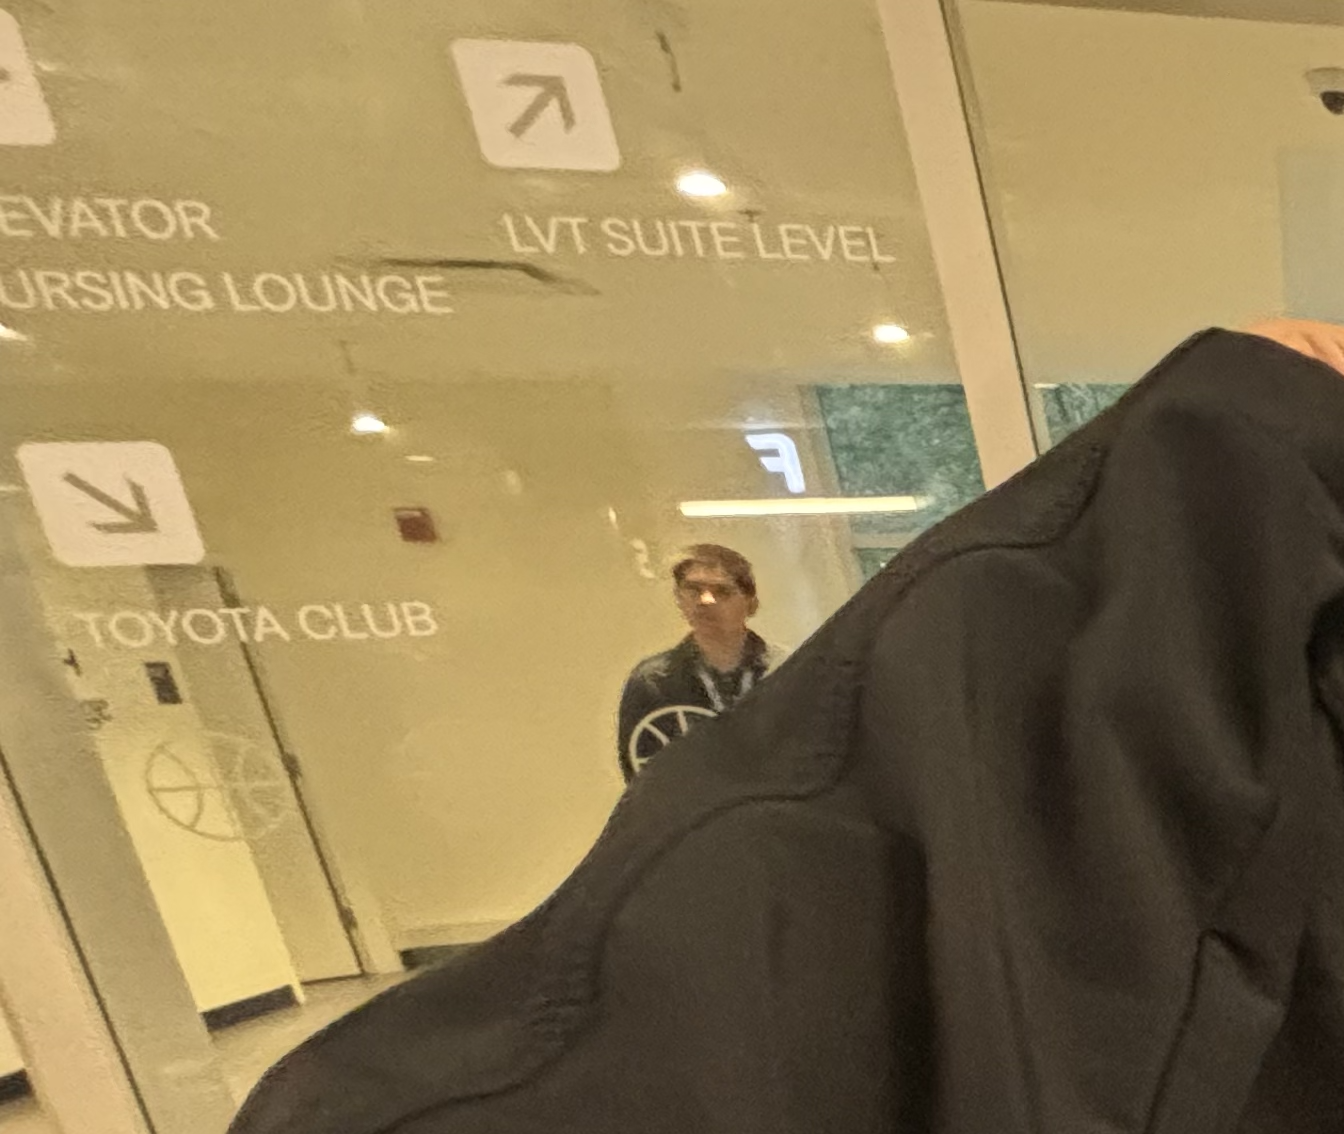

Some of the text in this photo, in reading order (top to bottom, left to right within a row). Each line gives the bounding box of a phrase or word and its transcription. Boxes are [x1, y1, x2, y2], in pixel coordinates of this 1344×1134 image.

[0, 196, 220, 240] EVATOR
[502, 213, 897, 264] LVT SUITE LEVEL
[0, 268, 455, 314] URSING LOUNGE
[73, 600, 438, 648] TOYOTA CLUB
